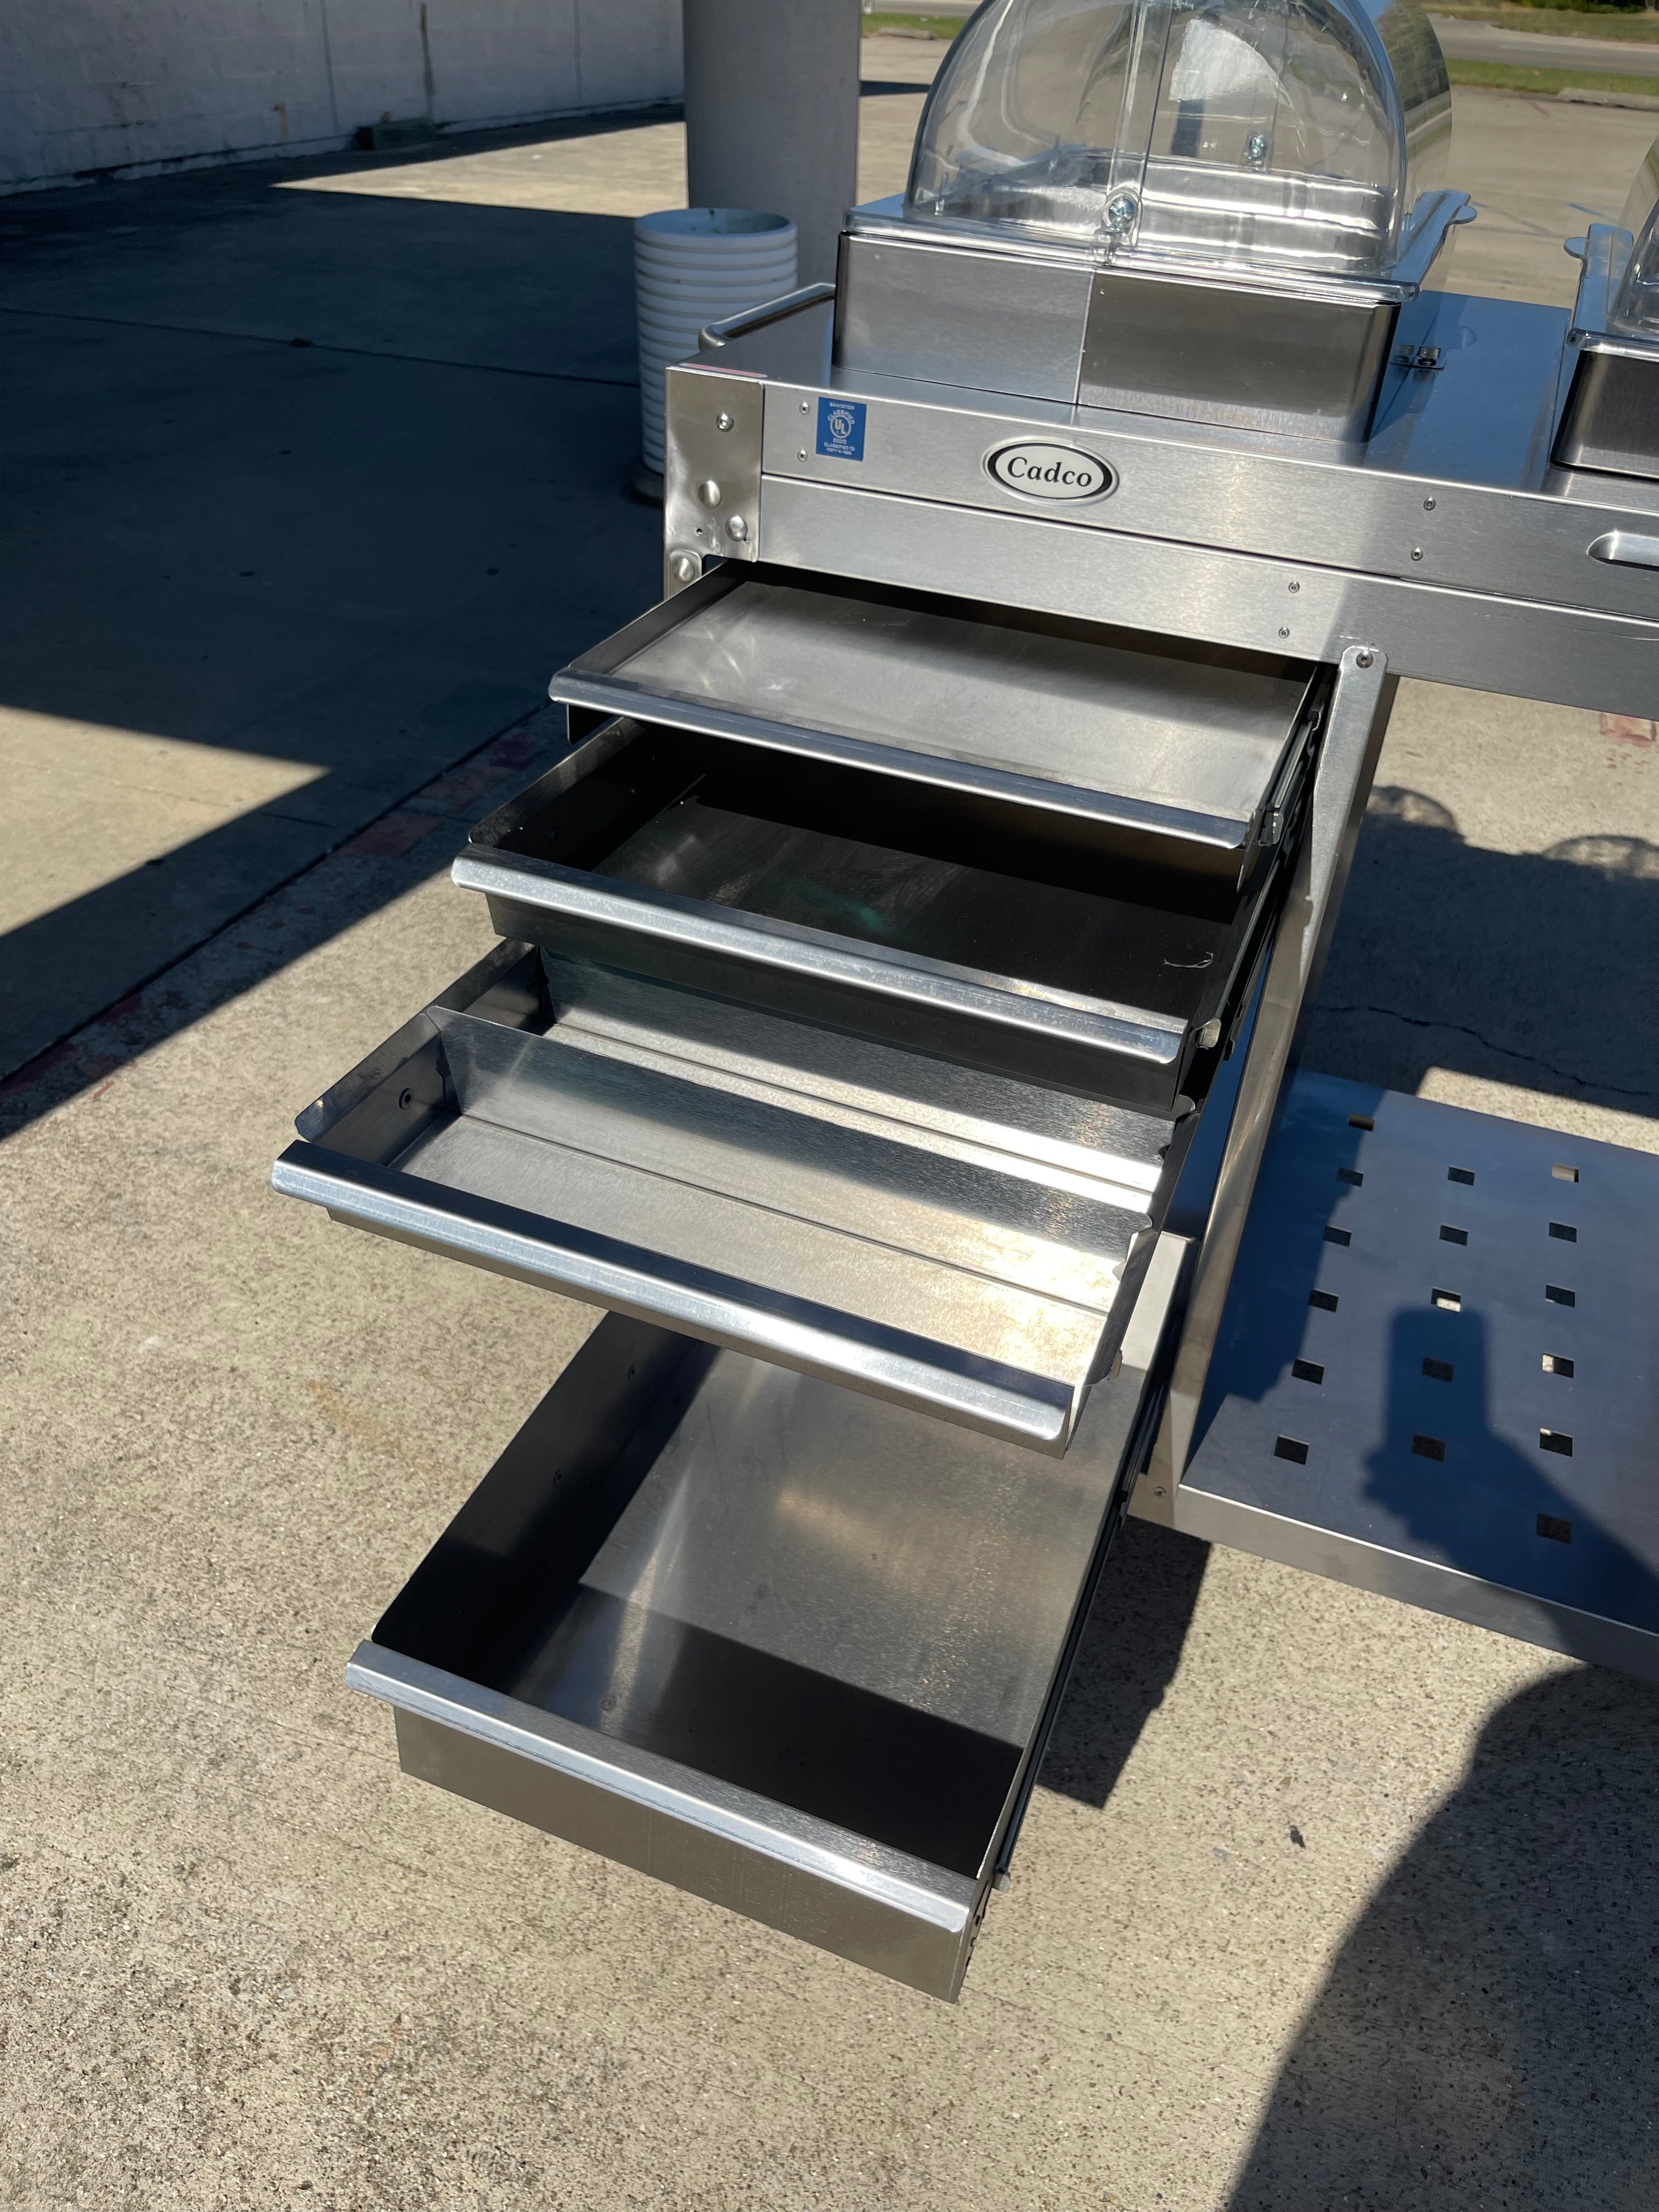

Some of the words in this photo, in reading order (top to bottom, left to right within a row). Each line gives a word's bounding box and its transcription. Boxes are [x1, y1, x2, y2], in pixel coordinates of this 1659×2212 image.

[827, 409, 855, 425] CLASSIFIED
[835, 419, 847, 435] UL
[1007, 456, 1092, 487] Cadco
